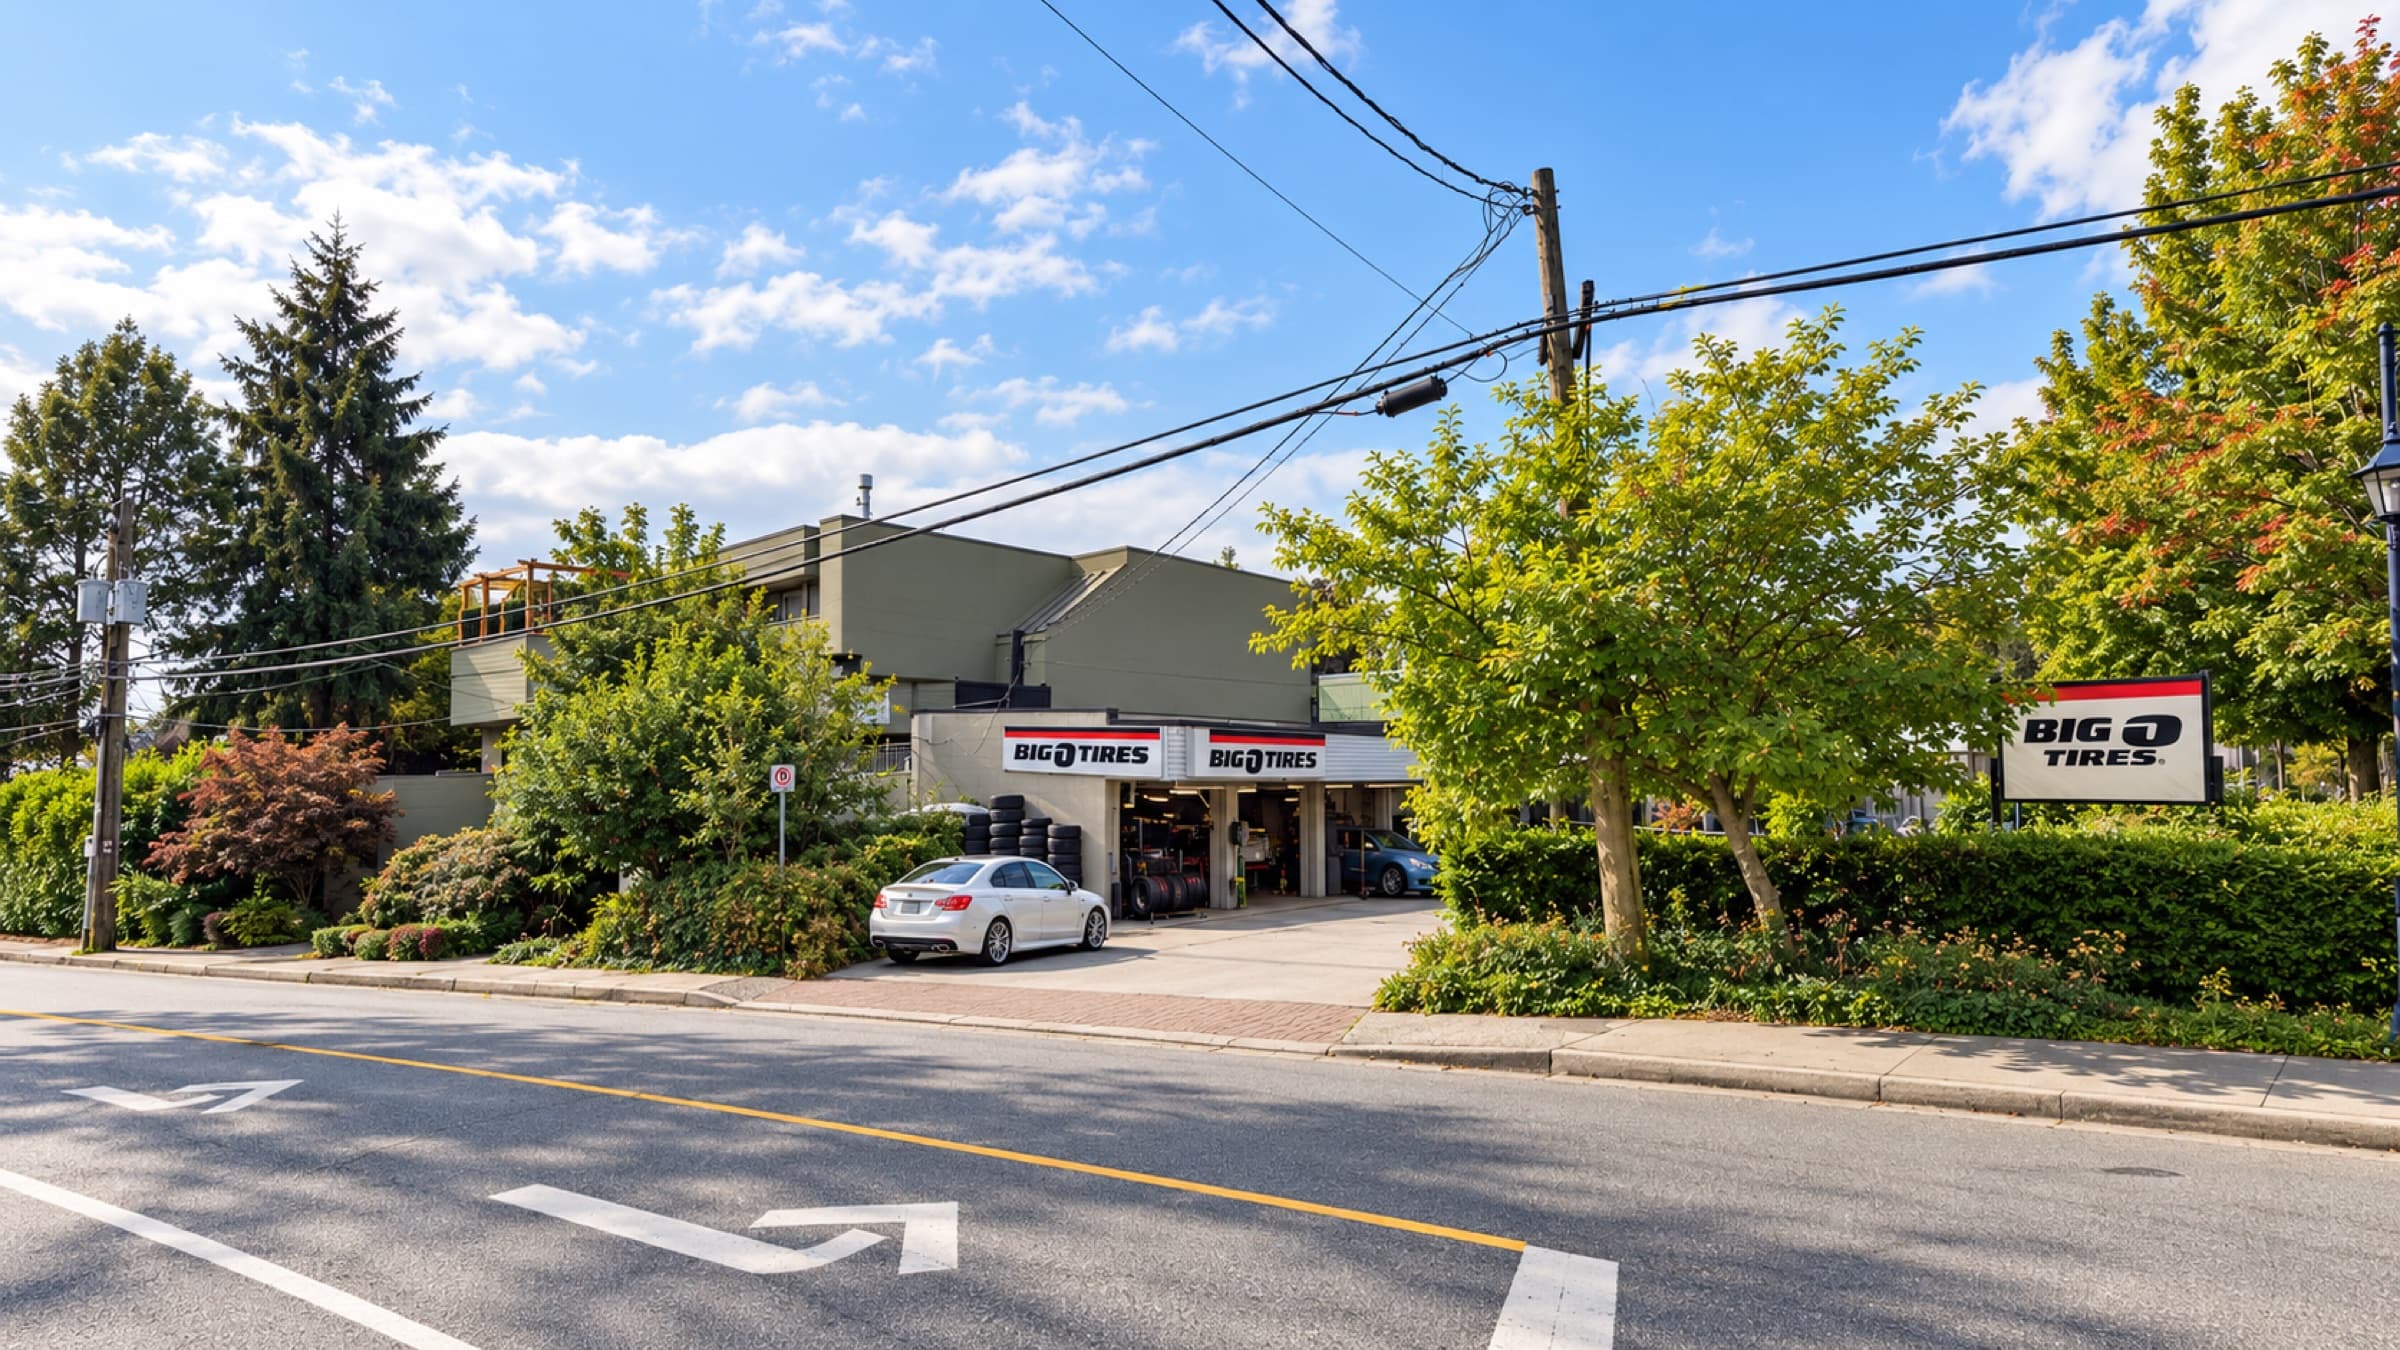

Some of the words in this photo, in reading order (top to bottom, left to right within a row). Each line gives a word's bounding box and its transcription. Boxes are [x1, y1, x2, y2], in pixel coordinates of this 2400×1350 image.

[2023, 718, 2112, 744] BIG
[2121, 714, 2183, 747] O
[1013, 743, 1053, 761] BIG
[1078, 744, 1149, 765] TIRES
[1209, 748, 1244, 769] BIG
[1265, 750, 1317, 769] TIRES
